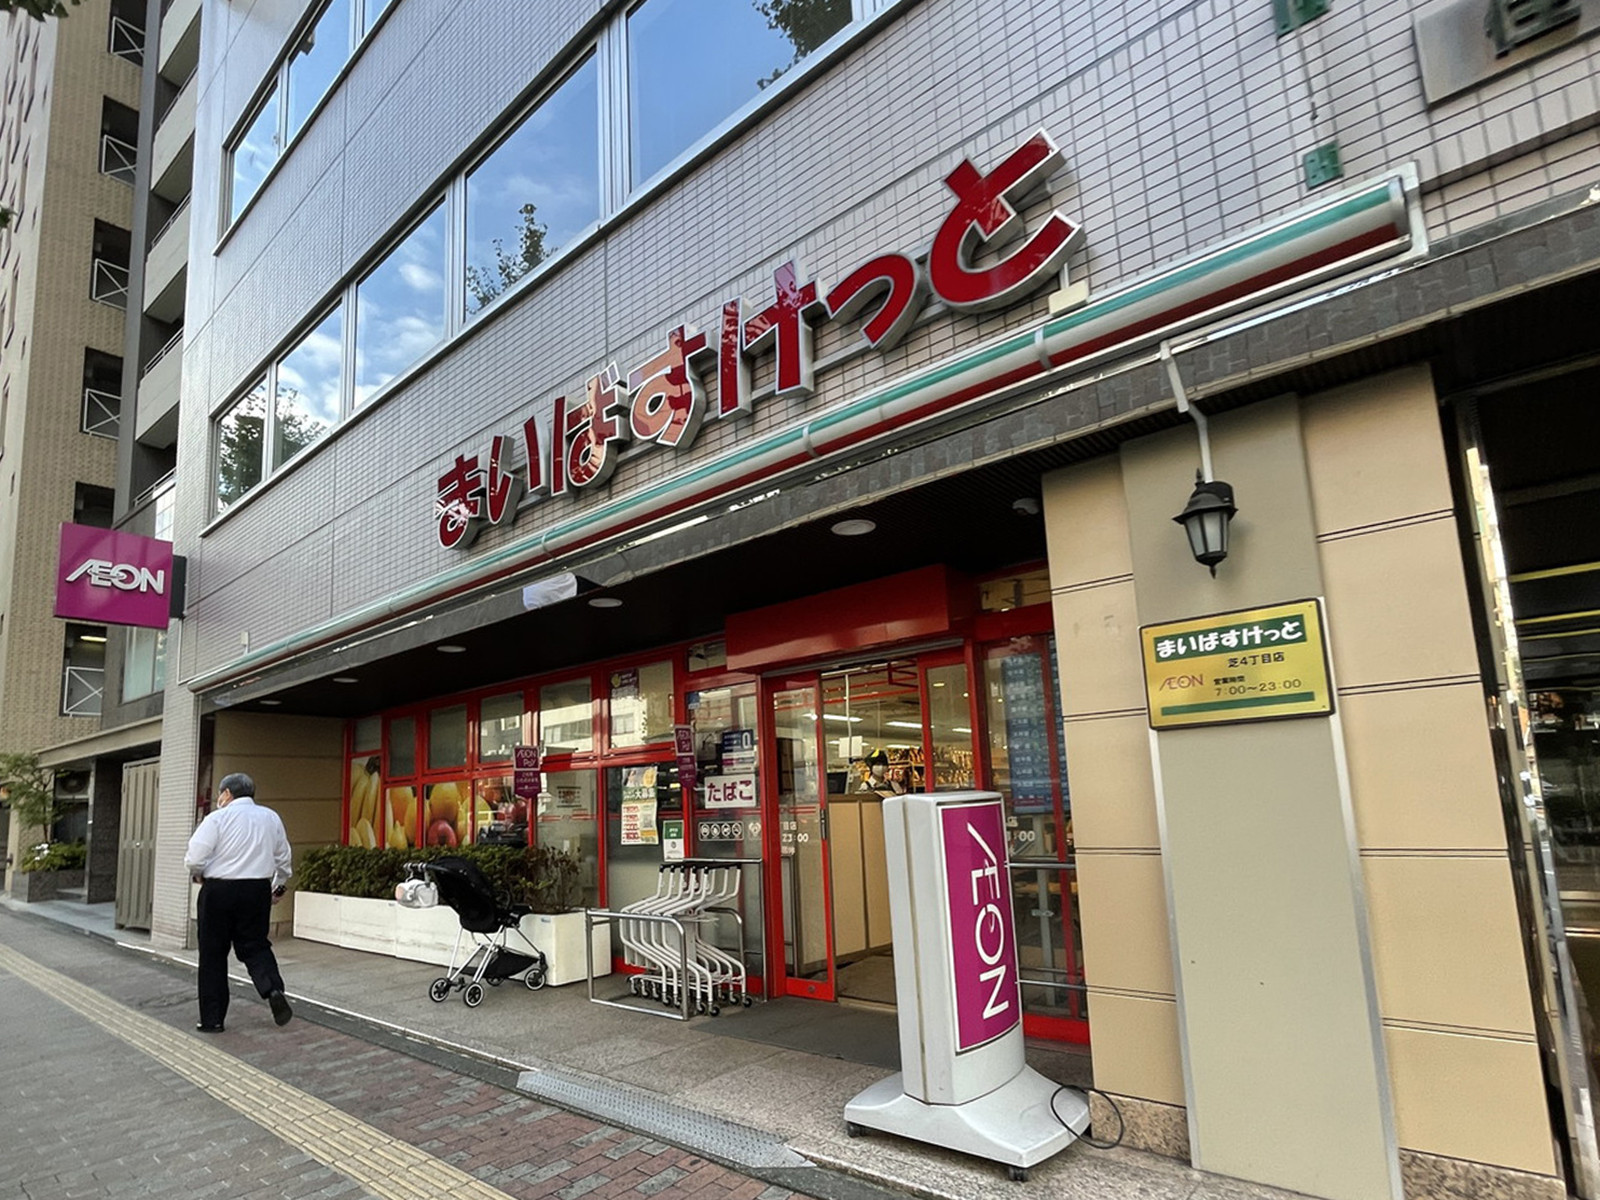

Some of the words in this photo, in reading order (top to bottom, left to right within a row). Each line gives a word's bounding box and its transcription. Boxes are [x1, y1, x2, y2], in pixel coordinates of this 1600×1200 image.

[435, 126, 1085, 549] まいばすけっと
[1156, 620, 1303, 659] まいばすけっと
[1228, 652, 1285, 668] 芝4丁目店
[707, 780, 753, 802] たばこ
[782, 832, 809, 843] 23:00
